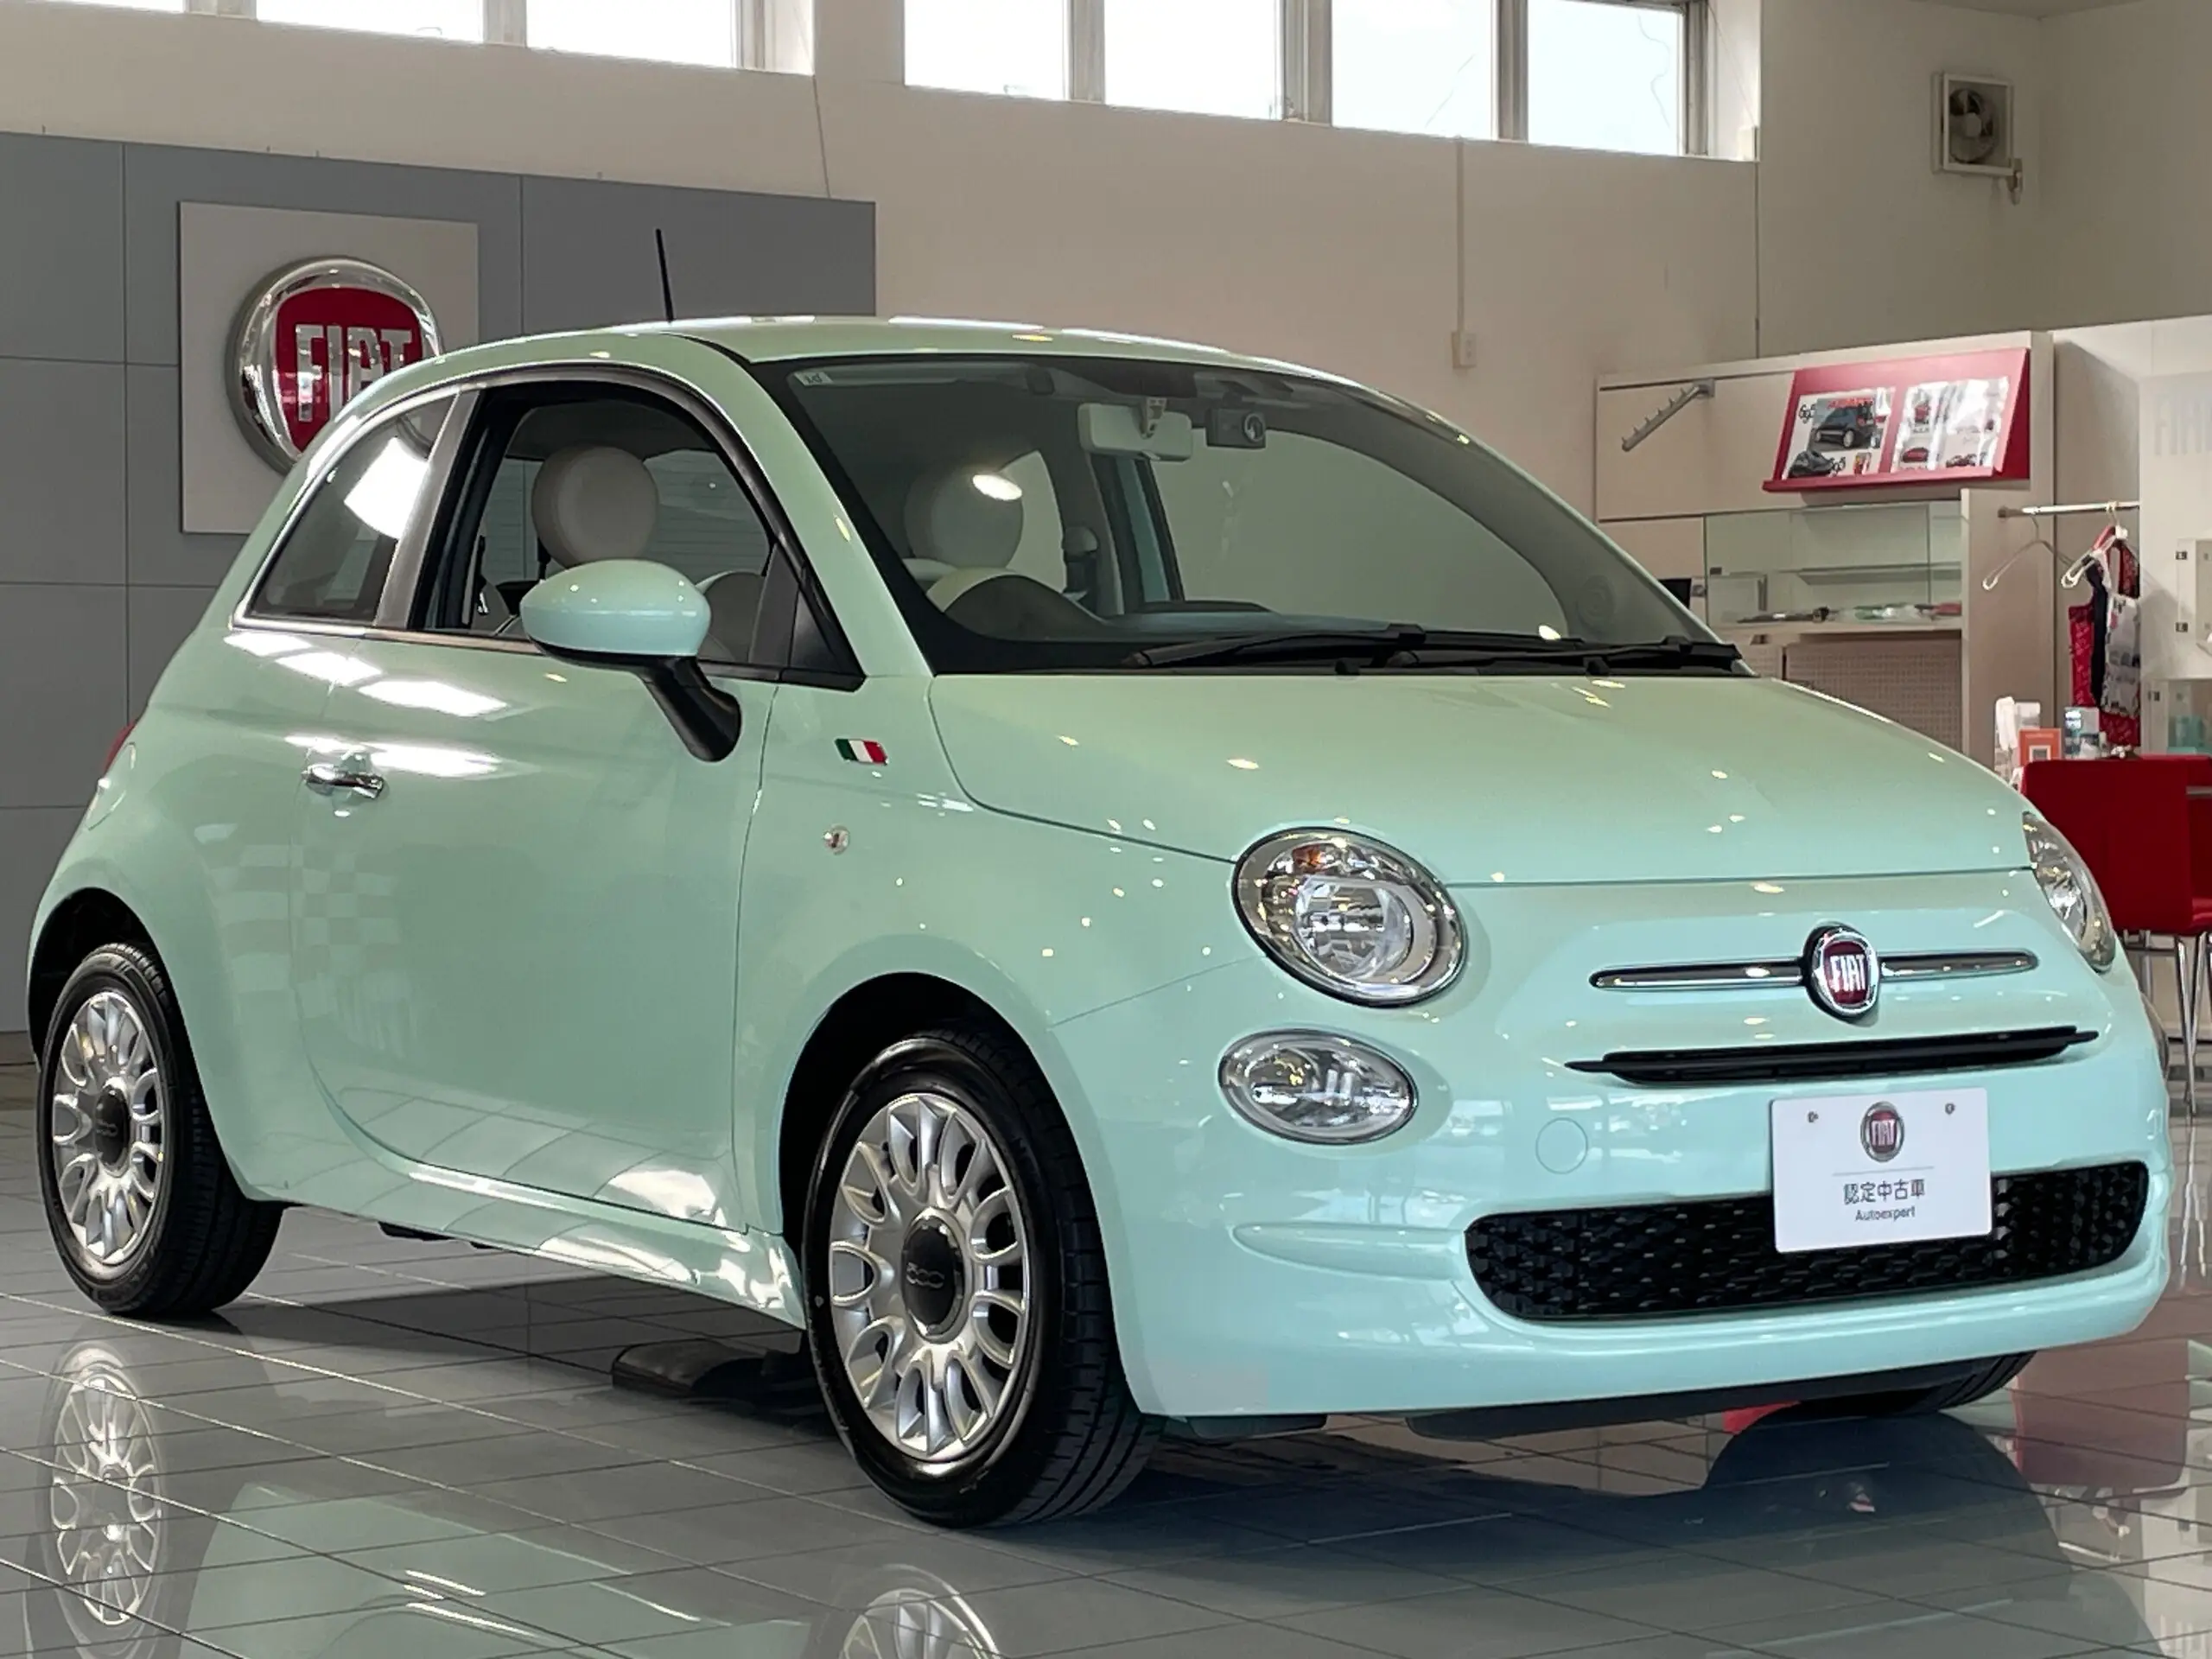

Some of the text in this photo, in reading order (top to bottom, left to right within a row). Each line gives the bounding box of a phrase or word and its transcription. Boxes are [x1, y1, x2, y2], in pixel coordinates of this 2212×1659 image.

[1830, 955, 1866, 993] FIAT
[1872, 1119, 1895, 1146] FIAT
[1844, 1179, 1925, 1205] 認定中古車
[1855, 1205, 1916, 1221] Autoexpert
